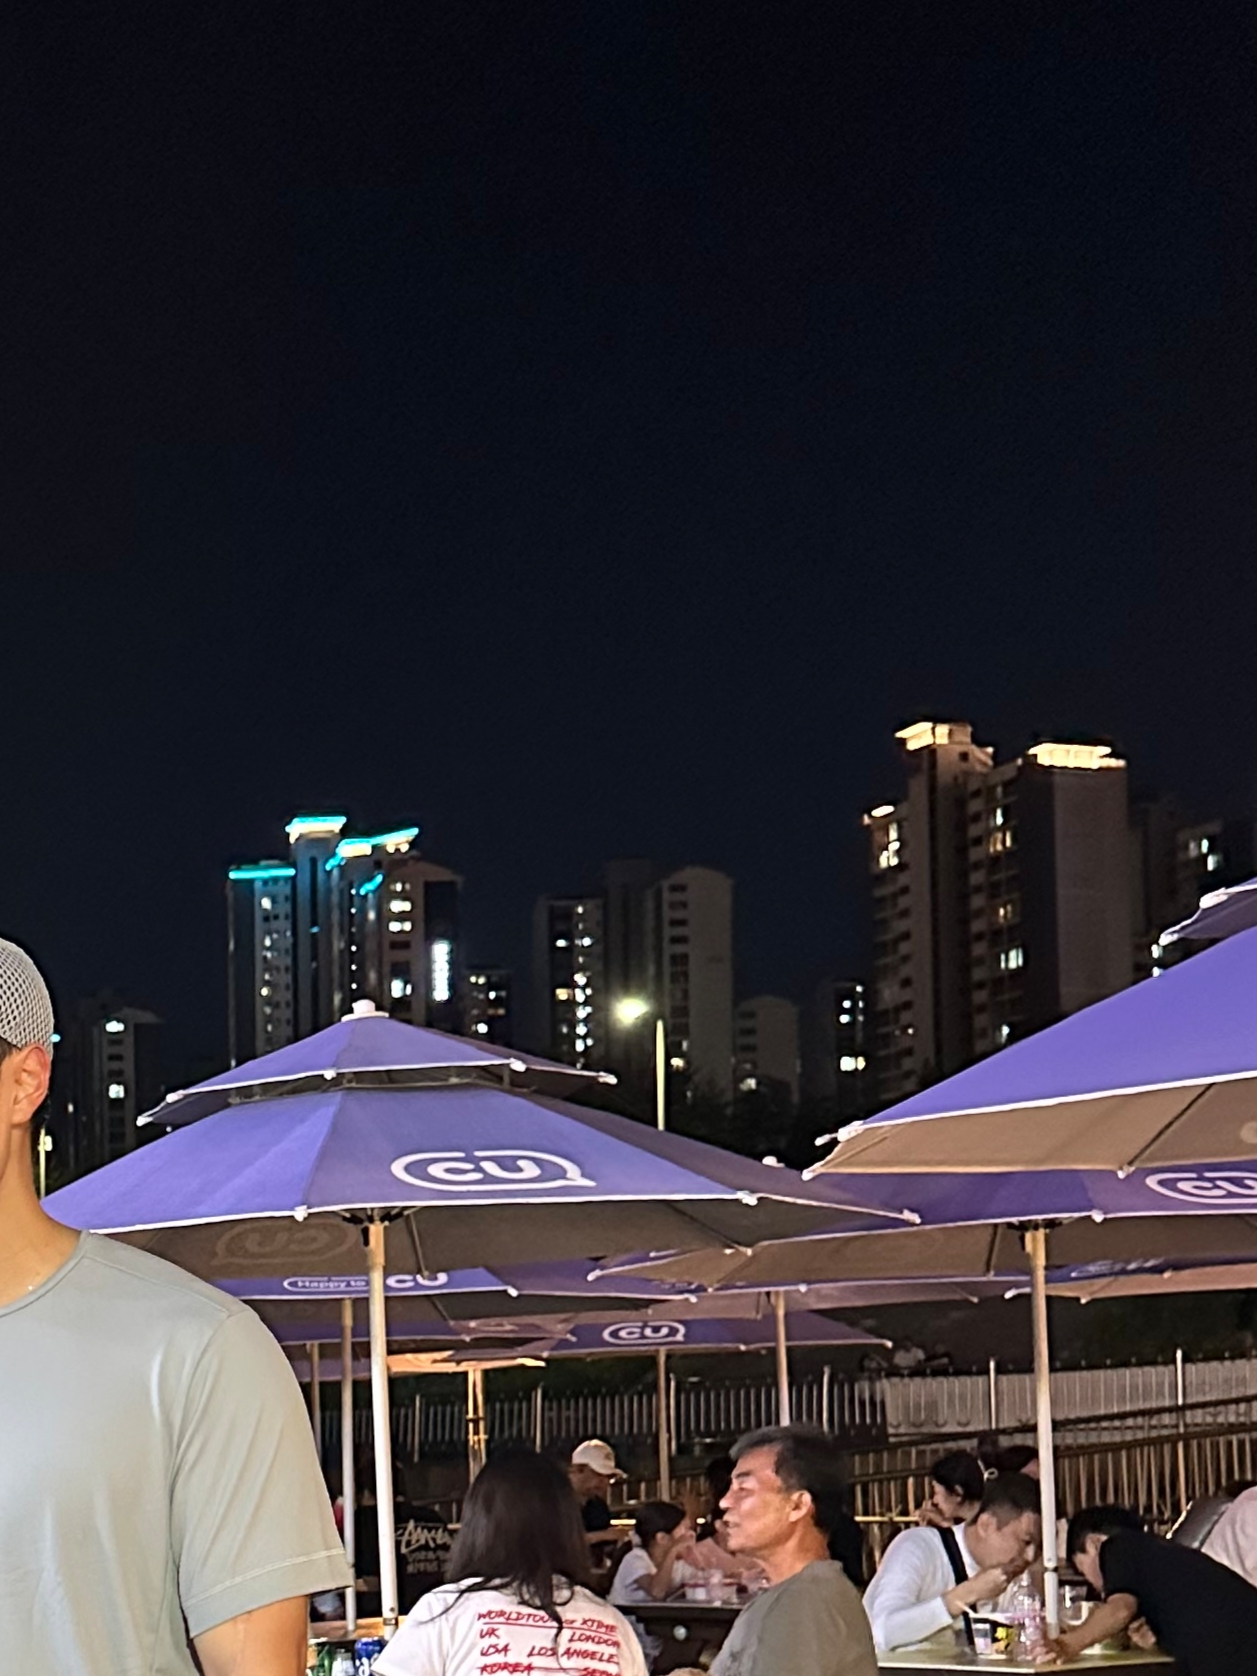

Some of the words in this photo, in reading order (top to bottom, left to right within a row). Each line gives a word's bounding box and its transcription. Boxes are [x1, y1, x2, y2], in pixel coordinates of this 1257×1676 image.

[427, 1159, 542, 1182] CU
[1176, 1179, 1257, 1197] CU
[297, 1279, 343, 1290] Happy
[350, 1279, 366, 1288] to
[386, 1272, 448, 1289] CU
[617, 1325, 671, 1339] CU
[477, 1609, 555, 1624] WORLDTOU
[479, 1627, 500, 1640] UK
[568, 1631, 621, 1649] LONDON
[480, 1643, 511, 1657] USA
[527, 1645, 556, 1657] LOS
[561, 1647, 620, 1665] ANGELE
[479, 1661, 535, 1676] KOREA
